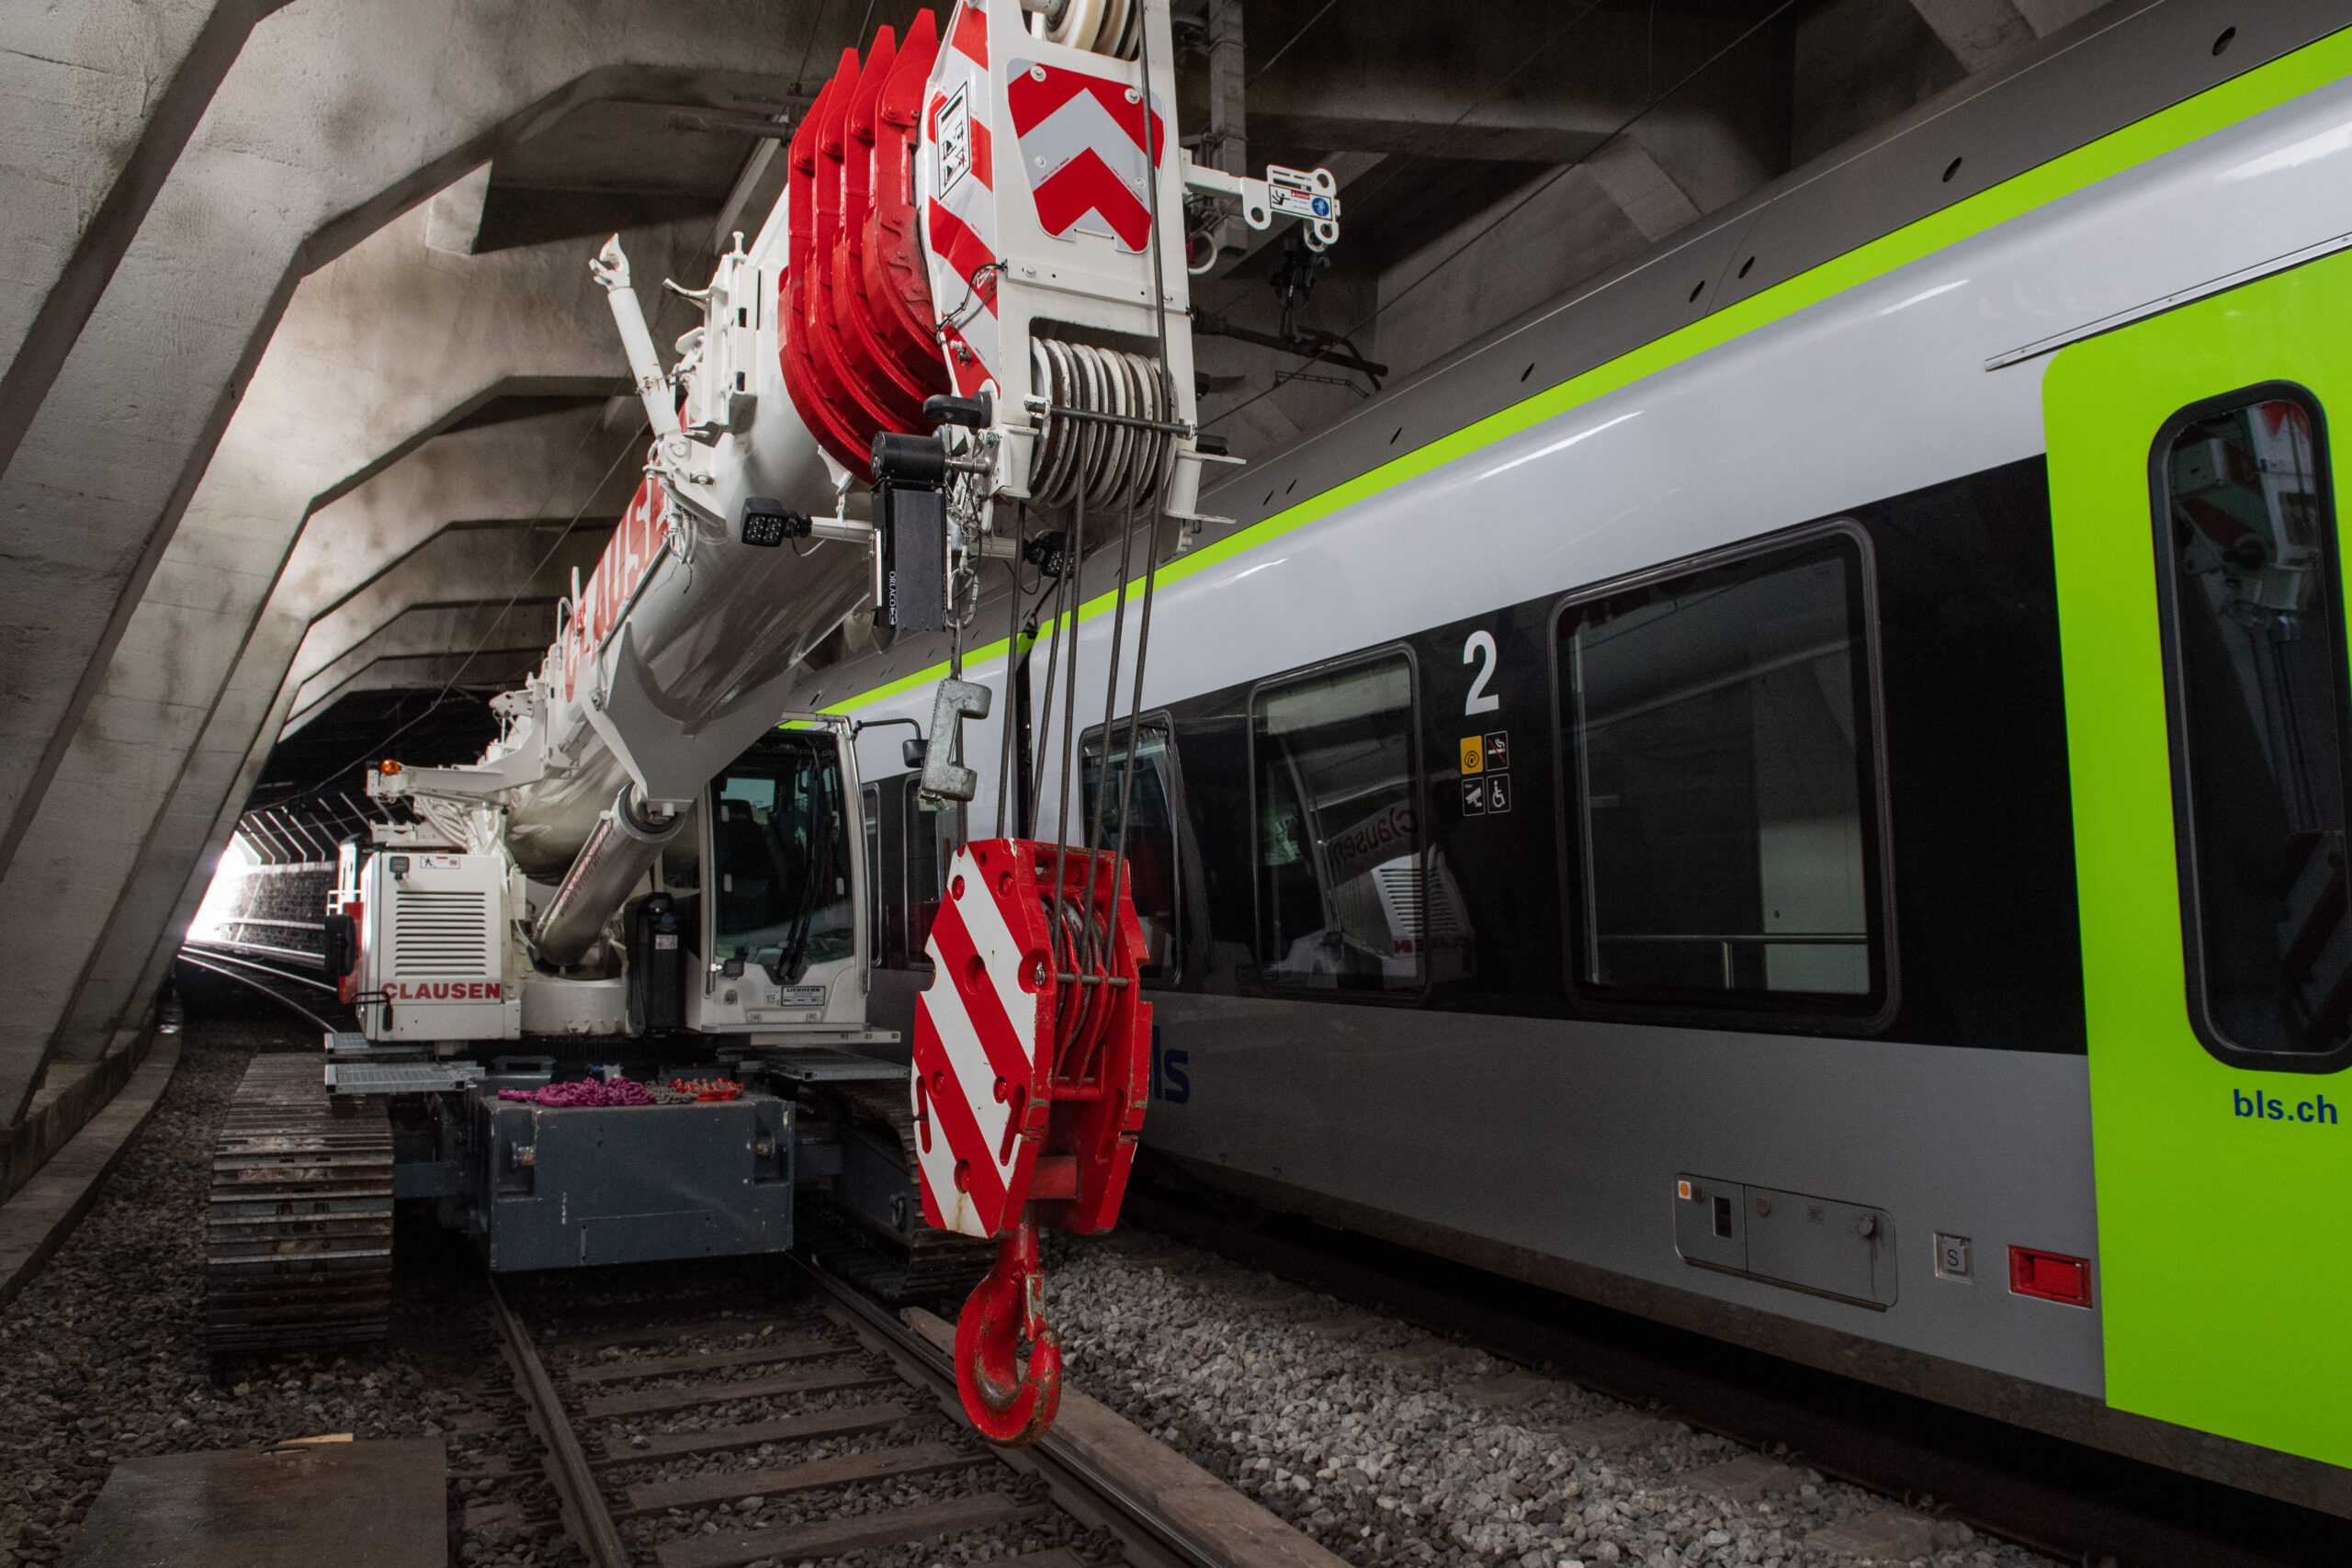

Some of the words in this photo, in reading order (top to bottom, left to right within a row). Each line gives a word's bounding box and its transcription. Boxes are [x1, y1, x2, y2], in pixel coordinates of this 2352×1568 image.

[888, 570, 897, 607] ORLACO
[1463, 629, 1499, 716] 2
[381, 982, 501, 1000] CLAUSEN
[1148, 1025, 1191, 1104] ls
[2233, 1088, 2338, 1125] bls.ch
[1947, 1248, 1959, 1267] S
